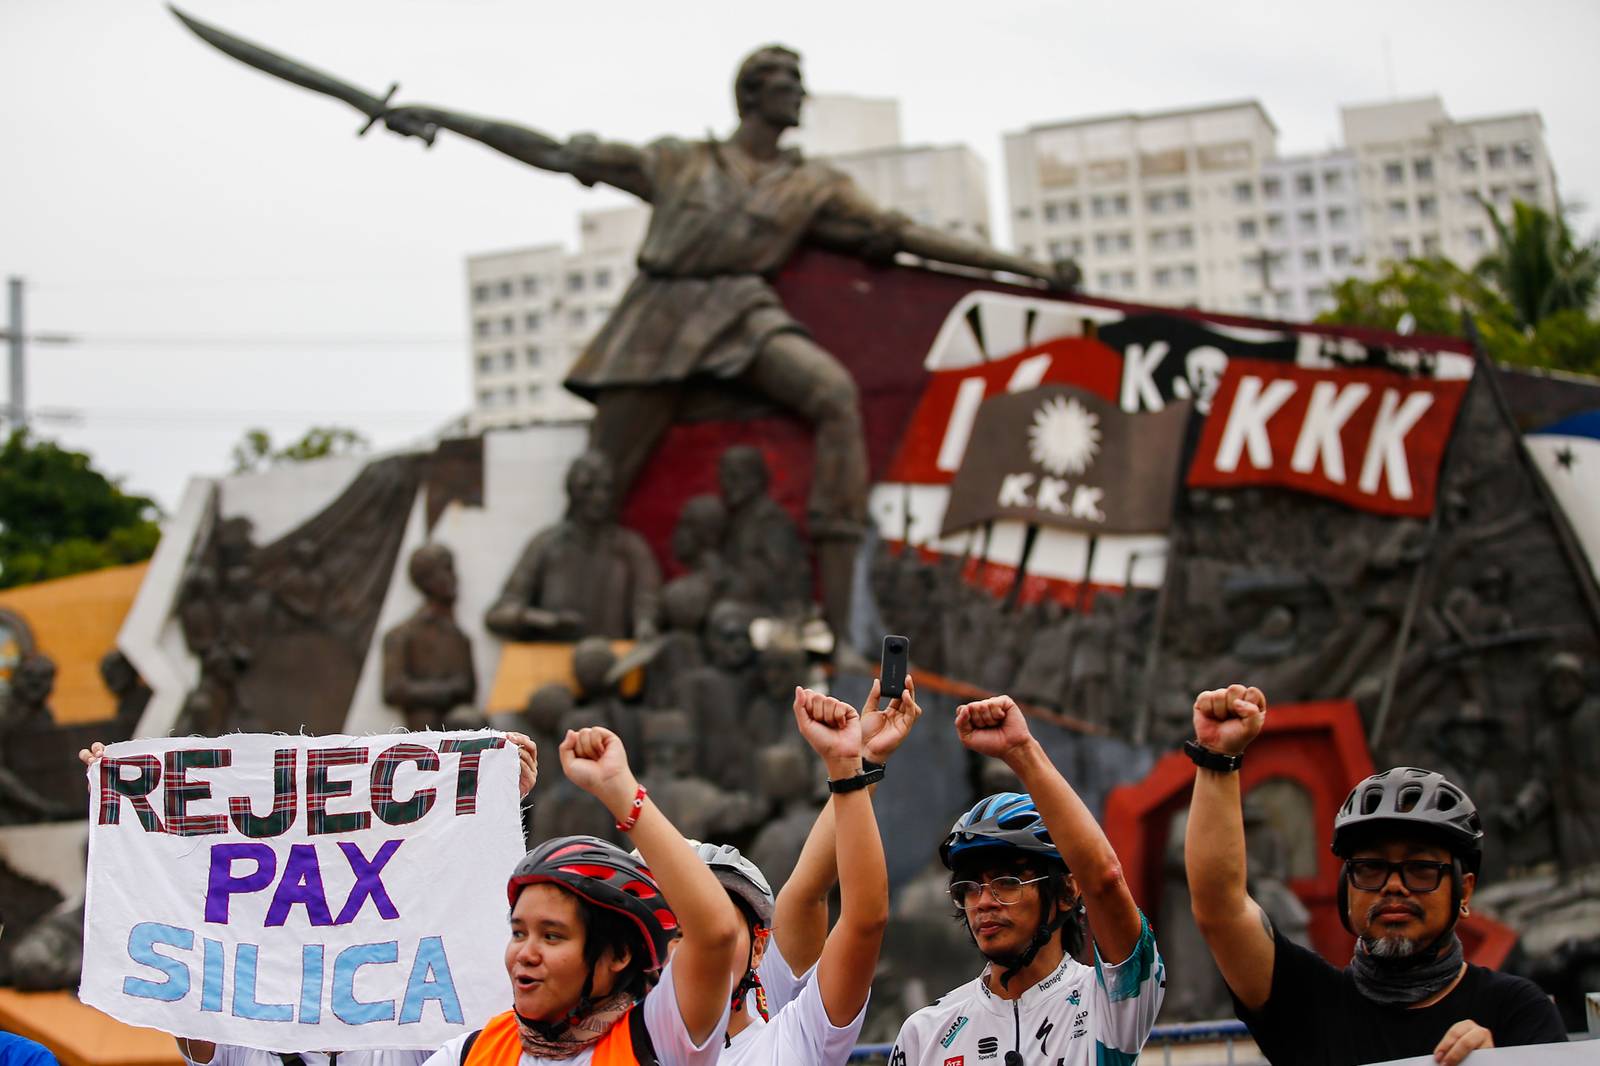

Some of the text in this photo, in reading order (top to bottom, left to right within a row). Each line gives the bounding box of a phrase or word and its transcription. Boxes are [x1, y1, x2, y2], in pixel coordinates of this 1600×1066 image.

[1215, 375, 1434, 500] KKK
[98, 737, 506, 838] REJECT
[204, 839, 404, 927] PAX
[122, 922, 465, 1026] SILICA
